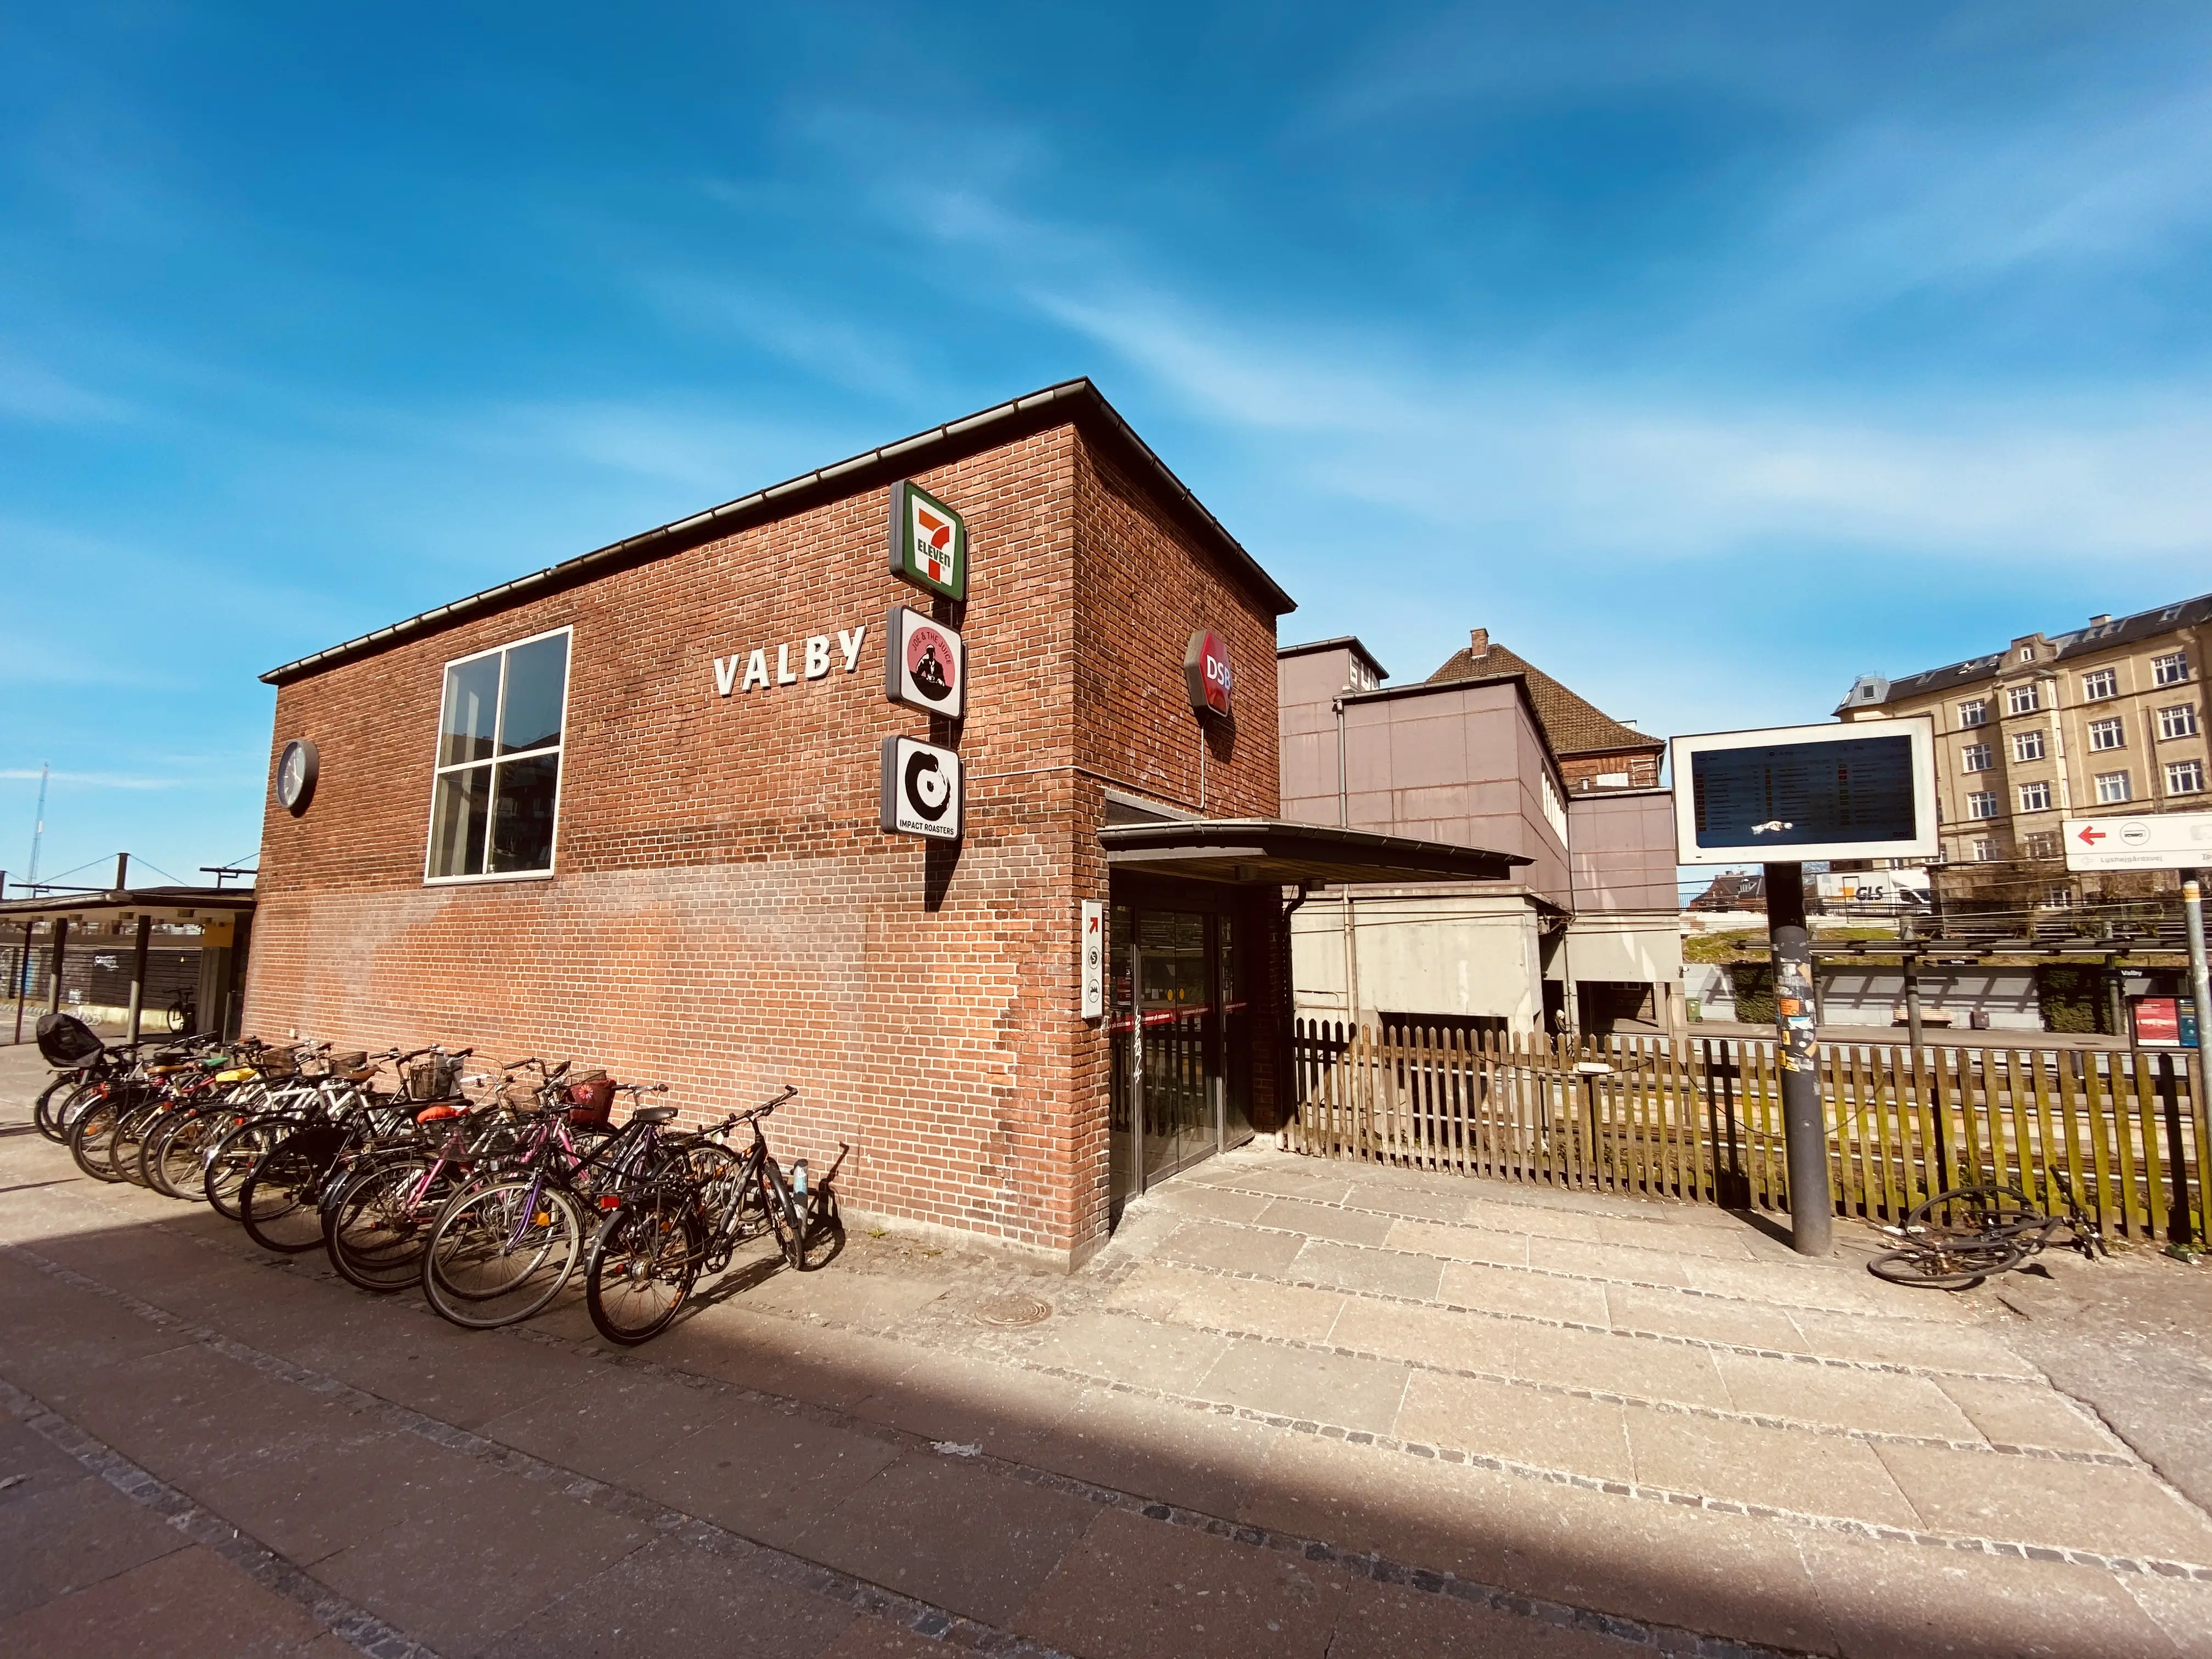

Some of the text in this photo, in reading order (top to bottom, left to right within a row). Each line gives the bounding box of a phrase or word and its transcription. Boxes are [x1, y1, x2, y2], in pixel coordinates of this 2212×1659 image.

[714, 625, 866, 696] VALBY
[911, 631, 952, 665] JOE & THE JUICE
[1206, 654, 1231, 690] DSB
[899, 819, 955, 836] IMPACT ROASTERS
[1855, 886, 1883, 900] GLS
